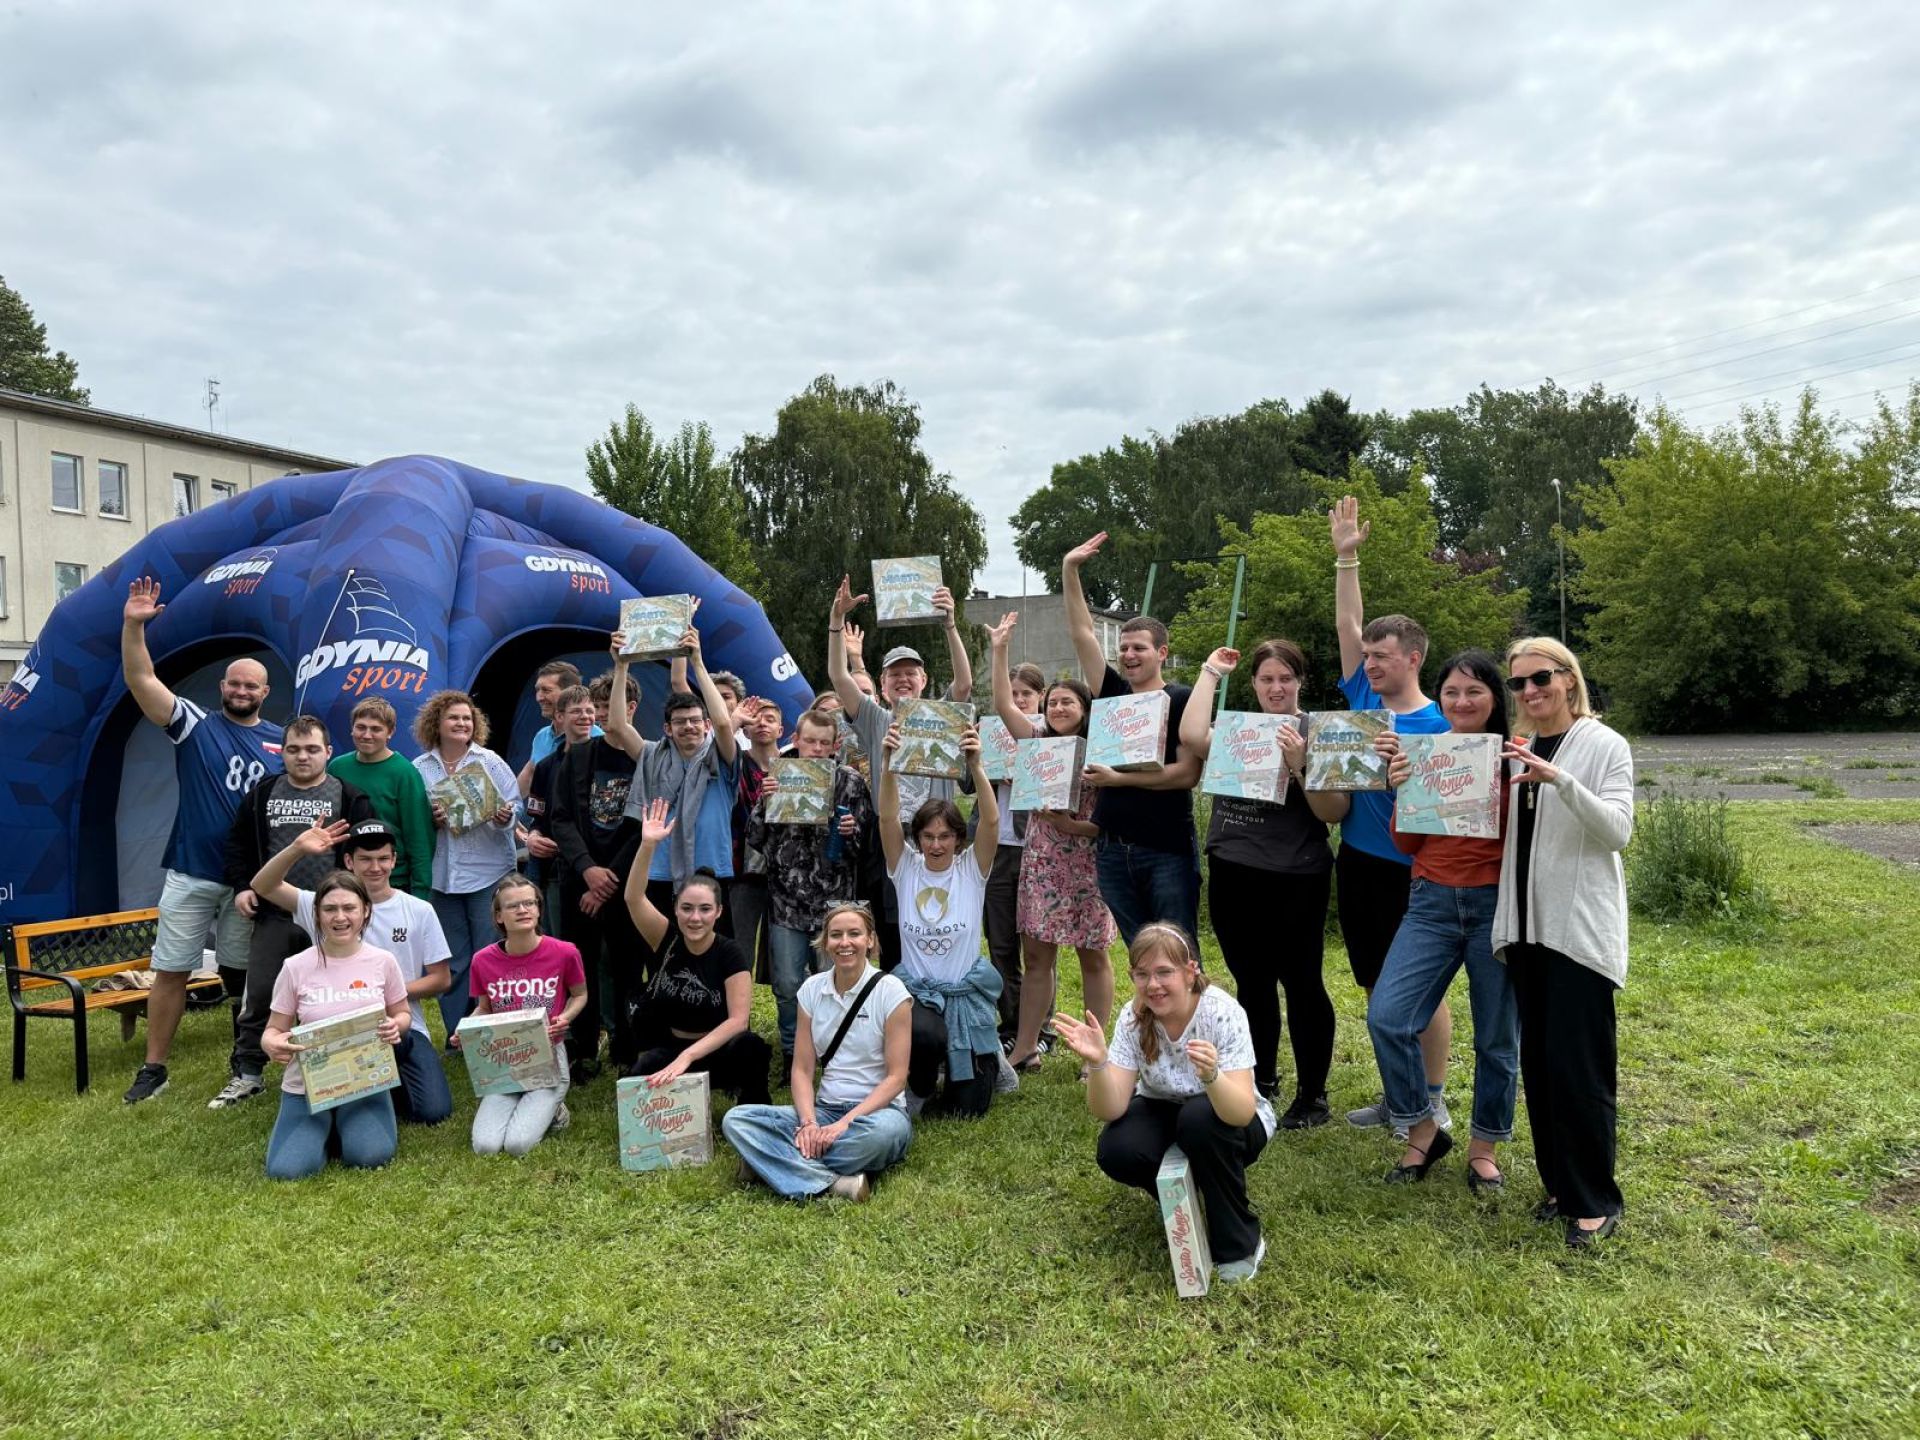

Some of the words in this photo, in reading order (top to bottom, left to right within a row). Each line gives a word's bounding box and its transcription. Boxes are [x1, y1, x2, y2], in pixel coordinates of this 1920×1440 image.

[204, 560, 274, 584] GDYNIA
[525, 556, 606, 579] GDYNIA
[224, 576, 264, 598] sport
[571, 574, 611, 594] sport
[295, 639, 429, 689] GDYNIA
[341, 665, 428, 697] sport
[1412, 752, 1457, 777] Santa
[1422, 772, 1475, 797] Monica
[266, 799, 332, 809] CARTOON
[266, 808, 332, 817] NETWORK
[357, 824, 385, 834] VANS
[391, 935, 407, 943] GO
[392, 927, 407, 936] HU
[903, 921, 932, 936] PARIS
[935, 921, 967, 936] 2024
[487, 976, 559, 1000] strong
[477, 1036, 518, 1057] Santa
[491, 1046, 540, 1068] Monica
[632, 1095, 675, 1120] Santa
[643, 1109, 695, 1136] Monica
[1171, 1204, 1191, 1248] Monica
[1179, 1247, 1198, 1286] Santa
